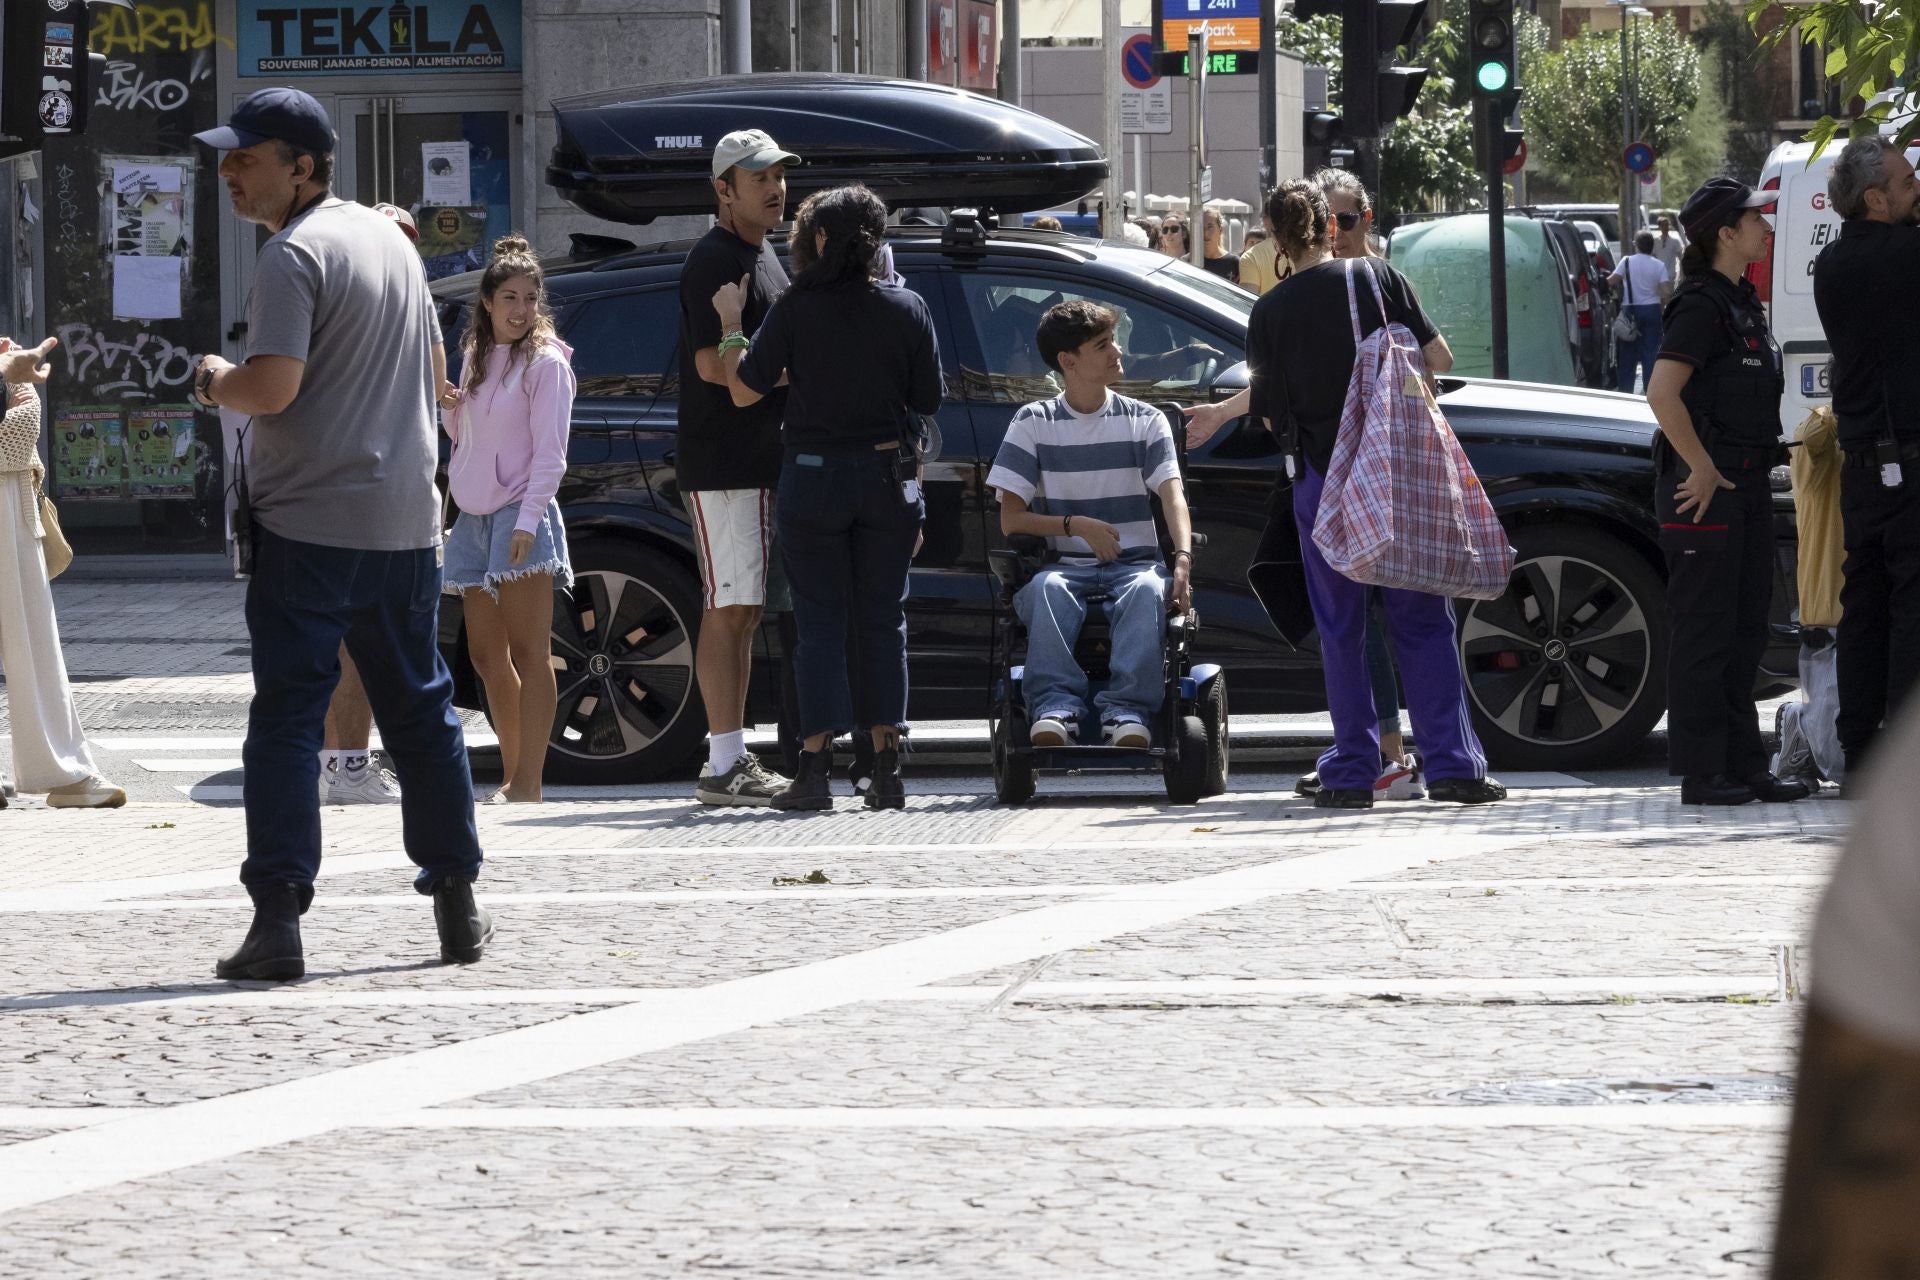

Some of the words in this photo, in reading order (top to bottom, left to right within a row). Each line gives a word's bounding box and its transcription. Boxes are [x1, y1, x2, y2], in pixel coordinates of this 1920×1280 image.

[256, 0, 504, 56] TEKILA
[259, 59, 319, 70] SOUVENIR
[323, 57, 411, 69] JANARI-DENDA
[416, 53, 502, 67] ALIMENTACIÓN
[1183, 54, 1237, 74] LBRE
[654, 135, 703, 149] THULE
